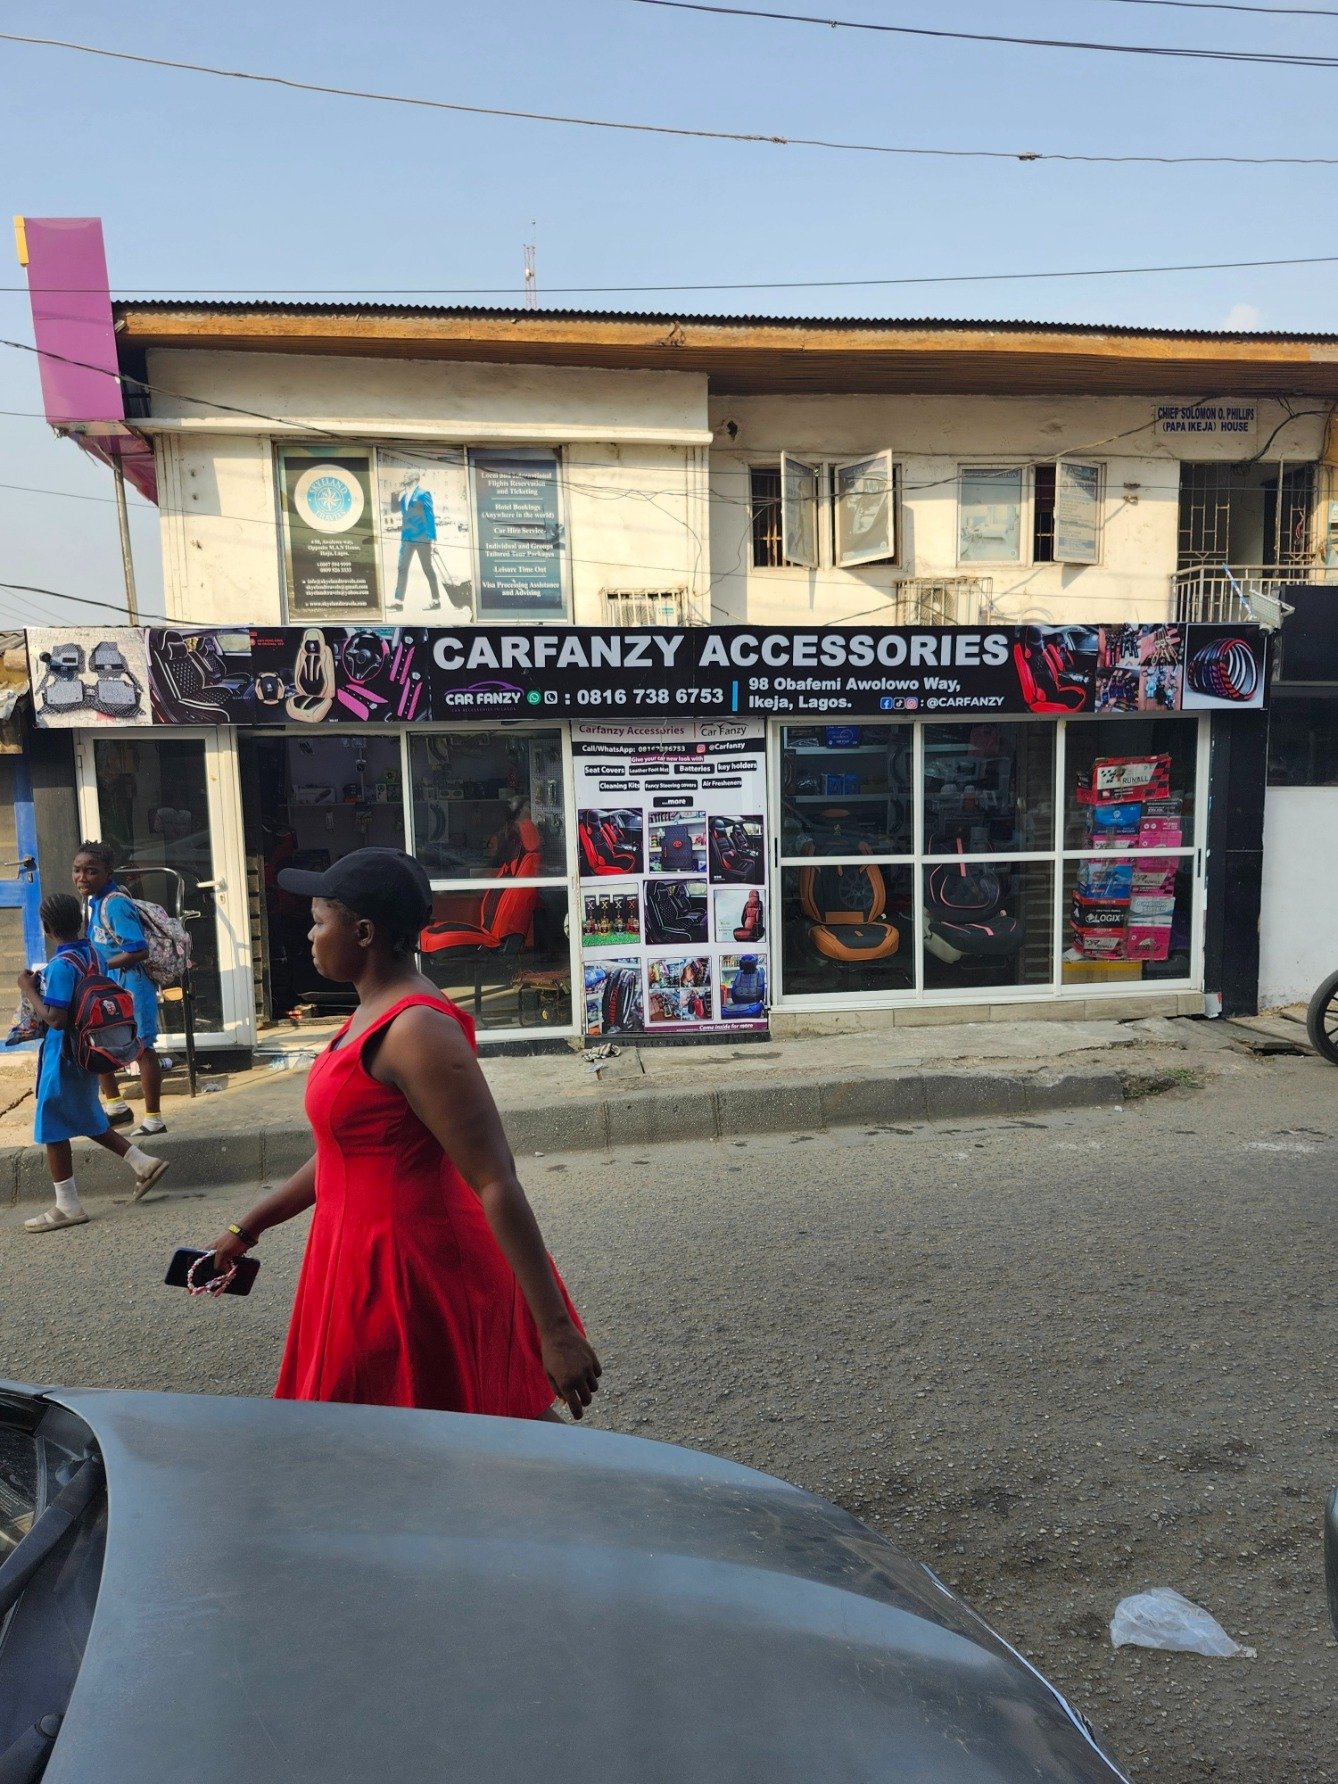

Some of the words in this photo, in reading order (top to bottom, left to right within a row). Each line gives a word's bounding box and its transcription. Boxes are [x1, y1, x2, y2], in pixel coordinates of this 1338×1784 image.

[1158, 407, 1178, 419] CHIEF
[1181, 407, 1216, 419] SOLOMON
[1227, 408, 1254, 420] PHILLIPS
[1163, 422, 1186, 432] (PAPA
[1188, 422, 1216, 432] IKEJA)
[1221, 422, 1248, 431] HOUSE
[513, 504, 541, 512] Bookings
[433, 635, 684, 671] CARFANZY
[699, 635, 1008, 666] ACCESSORIES
[749, 678, 768, 690] 98
[774, 678, 841, 690] Obafemi
[846, 678, 919, 690] Awolowo
[923, 678, 961, 692] Way,
[446, 694, 474, 705] CAR
[476, 692, 520, 705] FANZY
[577, 689, 626, 704] 0816
[633, 689, 669, 704] 738
[676, 688, 723, 704] 6753
[926, 696, 1004, 708] @CARFANZY
[749, 696, 793, 711] Ikeja,
[799, 696, 852, 710] Lagos.
[580, 725, 624, 737] Carfanzy
[627, 726, 684, 735] Accessories
[701, 728, 716, 736] Car
[720, 726, 747, 736] Fanzy
[582, 745, 636, 754] Call/WhatsApp:
[709, 743, 745, 751] @Carfanzy
[600, 782, 627, 790] Cleaning
